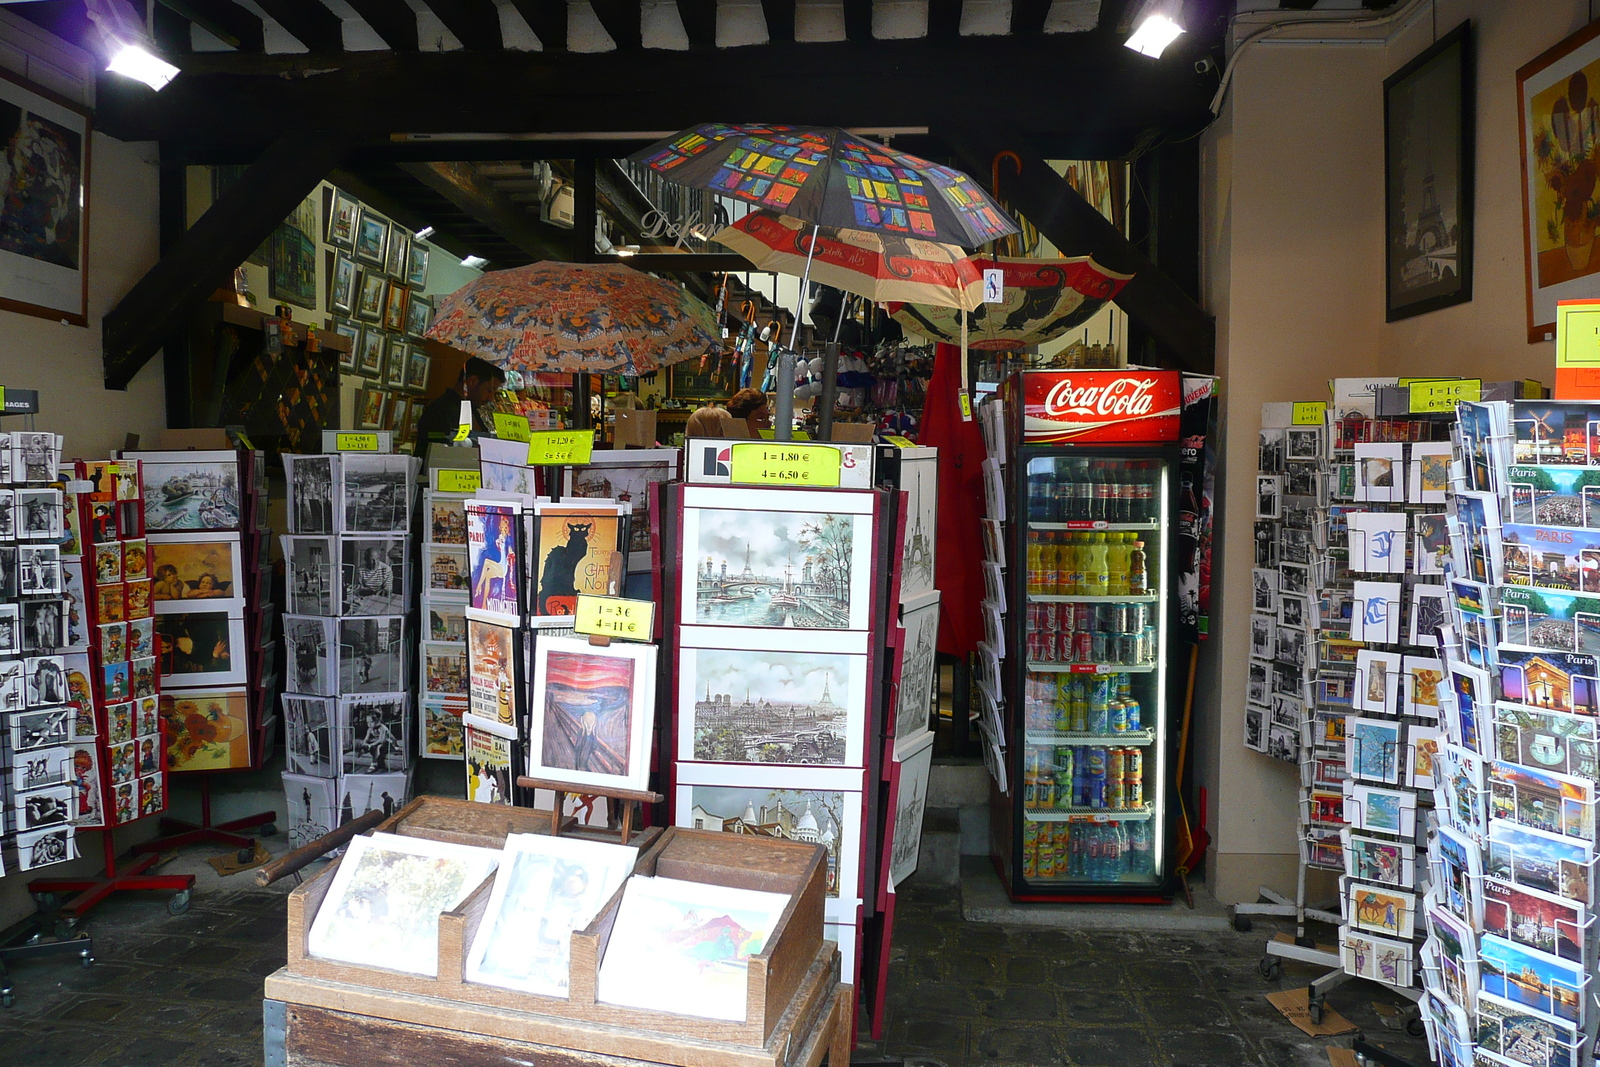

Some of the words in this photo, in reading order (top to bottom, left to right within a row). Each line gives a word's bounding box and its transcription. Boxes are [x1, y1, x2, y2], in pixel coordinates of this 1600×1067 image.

[1454, 386, 1461, 395] €
[1045, 378, 1159, 416] Coca-Cola
[1428, 400, 1435, 408] 6
[1445, 398, 1452, 407] 5
[557, 437, 569, 445] 1,20
[570, 436, 576, 444] €
[780, 452, 800, 462] 1,80
[802, 453, 810, 462] €
[1181, 448, 1197, 456] ero
[761, 470, 768, 479] 4
[778, 470, 799, 480] 6,50
[801, 471, 810, 480] €
[1508, 466, 1537, 477] Paris
[464, 474, 475, 482] 1,20
[468, 531, 485, 543] PARIS
[1534, 529, 1574, 544] PARIS
[584, 563, 610, 580] CHAT
[1504, 588, 1531, 600] Paris
[615, 606, 622, 616] 3
[624, 607, 632, 618] €
[596, 619, 602, 629] 4
[613, 621, 624, 632] 11
[627, 622, 637, 632] €
[1565, 653, 1595, 666] Paris
[494, 742, 506, 753] BAL
[1491, 761, 1517, 775] Paris
[1493, 872, 1512, 882] Par
[1485, 880, 1511, 896] Paris
[1483, 940, 1509, 955] Paris
